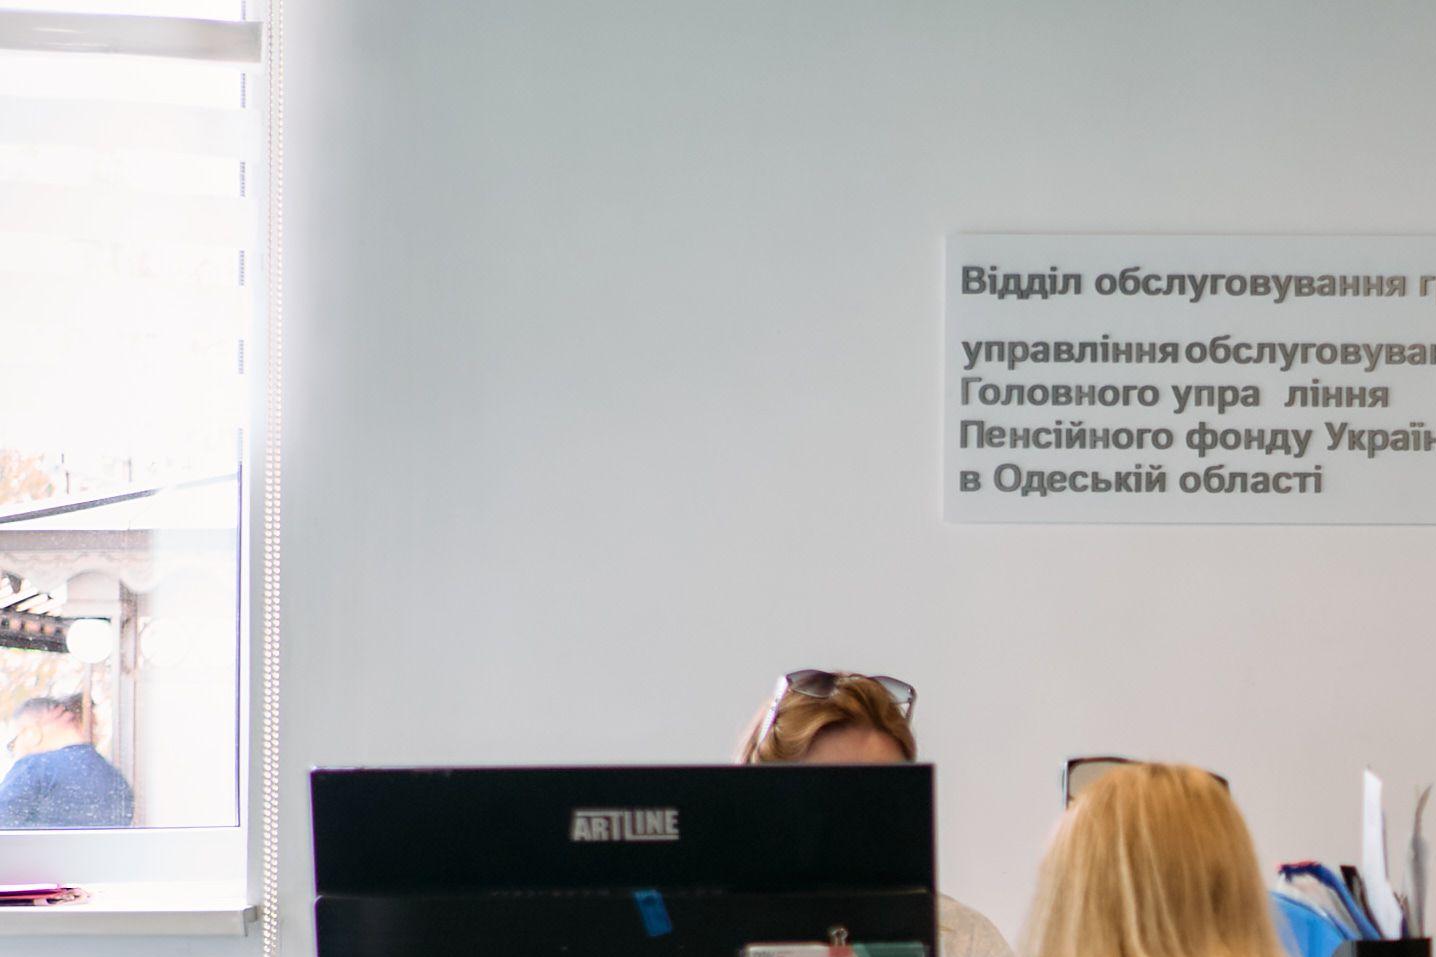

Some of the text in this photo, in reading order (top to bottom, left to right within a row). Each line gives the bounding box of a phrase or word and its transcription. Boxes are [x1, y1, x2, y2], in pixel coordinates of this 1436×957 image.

[961, 265, 1082, 300] Відділ
[1094, 265, 1407, 304] обслуговування
[961, 335, 1180, 374] управління
[961, 376, 1160, 407] Головного
[960, 419, 1174, 450] Пенсійного
[1185, 421, 1313, 459] фонду
[960, 462, 1323, 498] в Одеській області
[571, 809, 680, 841] ARTLINE
